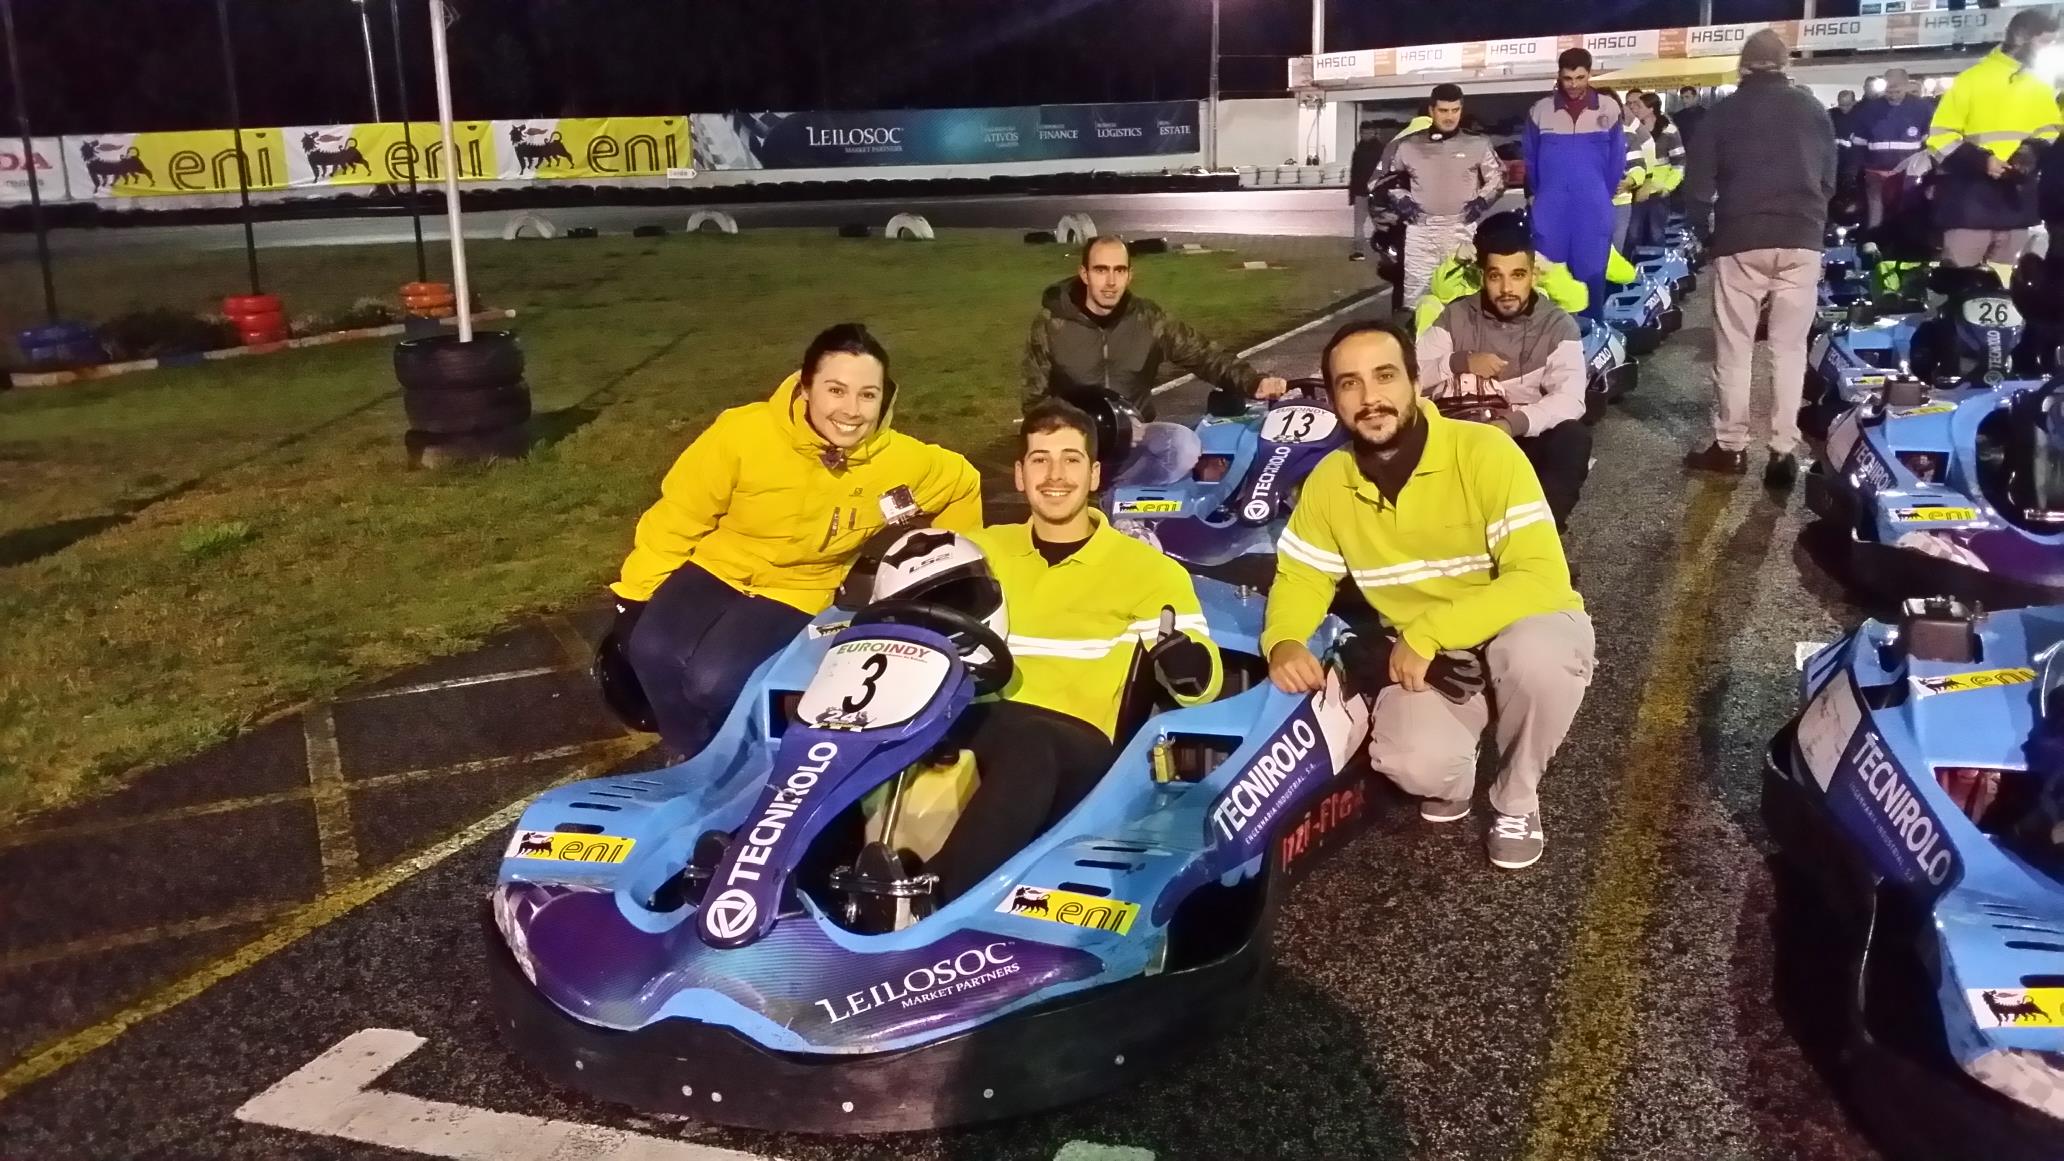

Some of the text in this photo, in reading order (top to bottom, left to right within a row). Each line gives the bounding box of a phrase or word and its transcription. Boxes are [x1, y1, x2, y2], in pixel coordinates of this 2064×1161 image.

[1803, 21, 1861, 37] HASCO
[1924, 13, 1987, 29] HASCO
[1587, 35, 1637, 50] HASCO
[1691, 28, 1745, 43] HASCO
[1400, 48, 1443, 62] HASCO
[1490, 42, 1537, 56] HASCO
[1316, 55, 1357, 70] HASCO
[804, 126, 902, 146] LEILOSOC
[1039, 129, 1080, 140] FINANCE
[1097, 127, 1143, 138] LOGISTICS
[1159, 125, 1192, 135] ESTATE
[385, 124, 484, 181] eni
[586, 119, 678, 173] eni
[168, 132, 274, 191] eni
[1978, 301, 2009, 324] 26
[1280, 410, 1315, 438] 13
[1142, 500, 1178, 513] eni
[1927, 507, 1974, 521] eni
[836, 641, 932, 658] EUROINDY
[841, 653, 888, 714] 3
[1970, 667, 2037, 688] eni
[1212, 718, 1316, 841] TECNIROLO
[727, 741, 838, 886] TECNIROLO
[1852, 730, 1952, 886] TECNIROLO
[557, 837, 629, 864] eni
[1055, 900, 1133, 933] eni
[814, 942, 1015, 1024] LEILOSOC
[900, 962, 1020, 1009] MARKET PARTNERS
